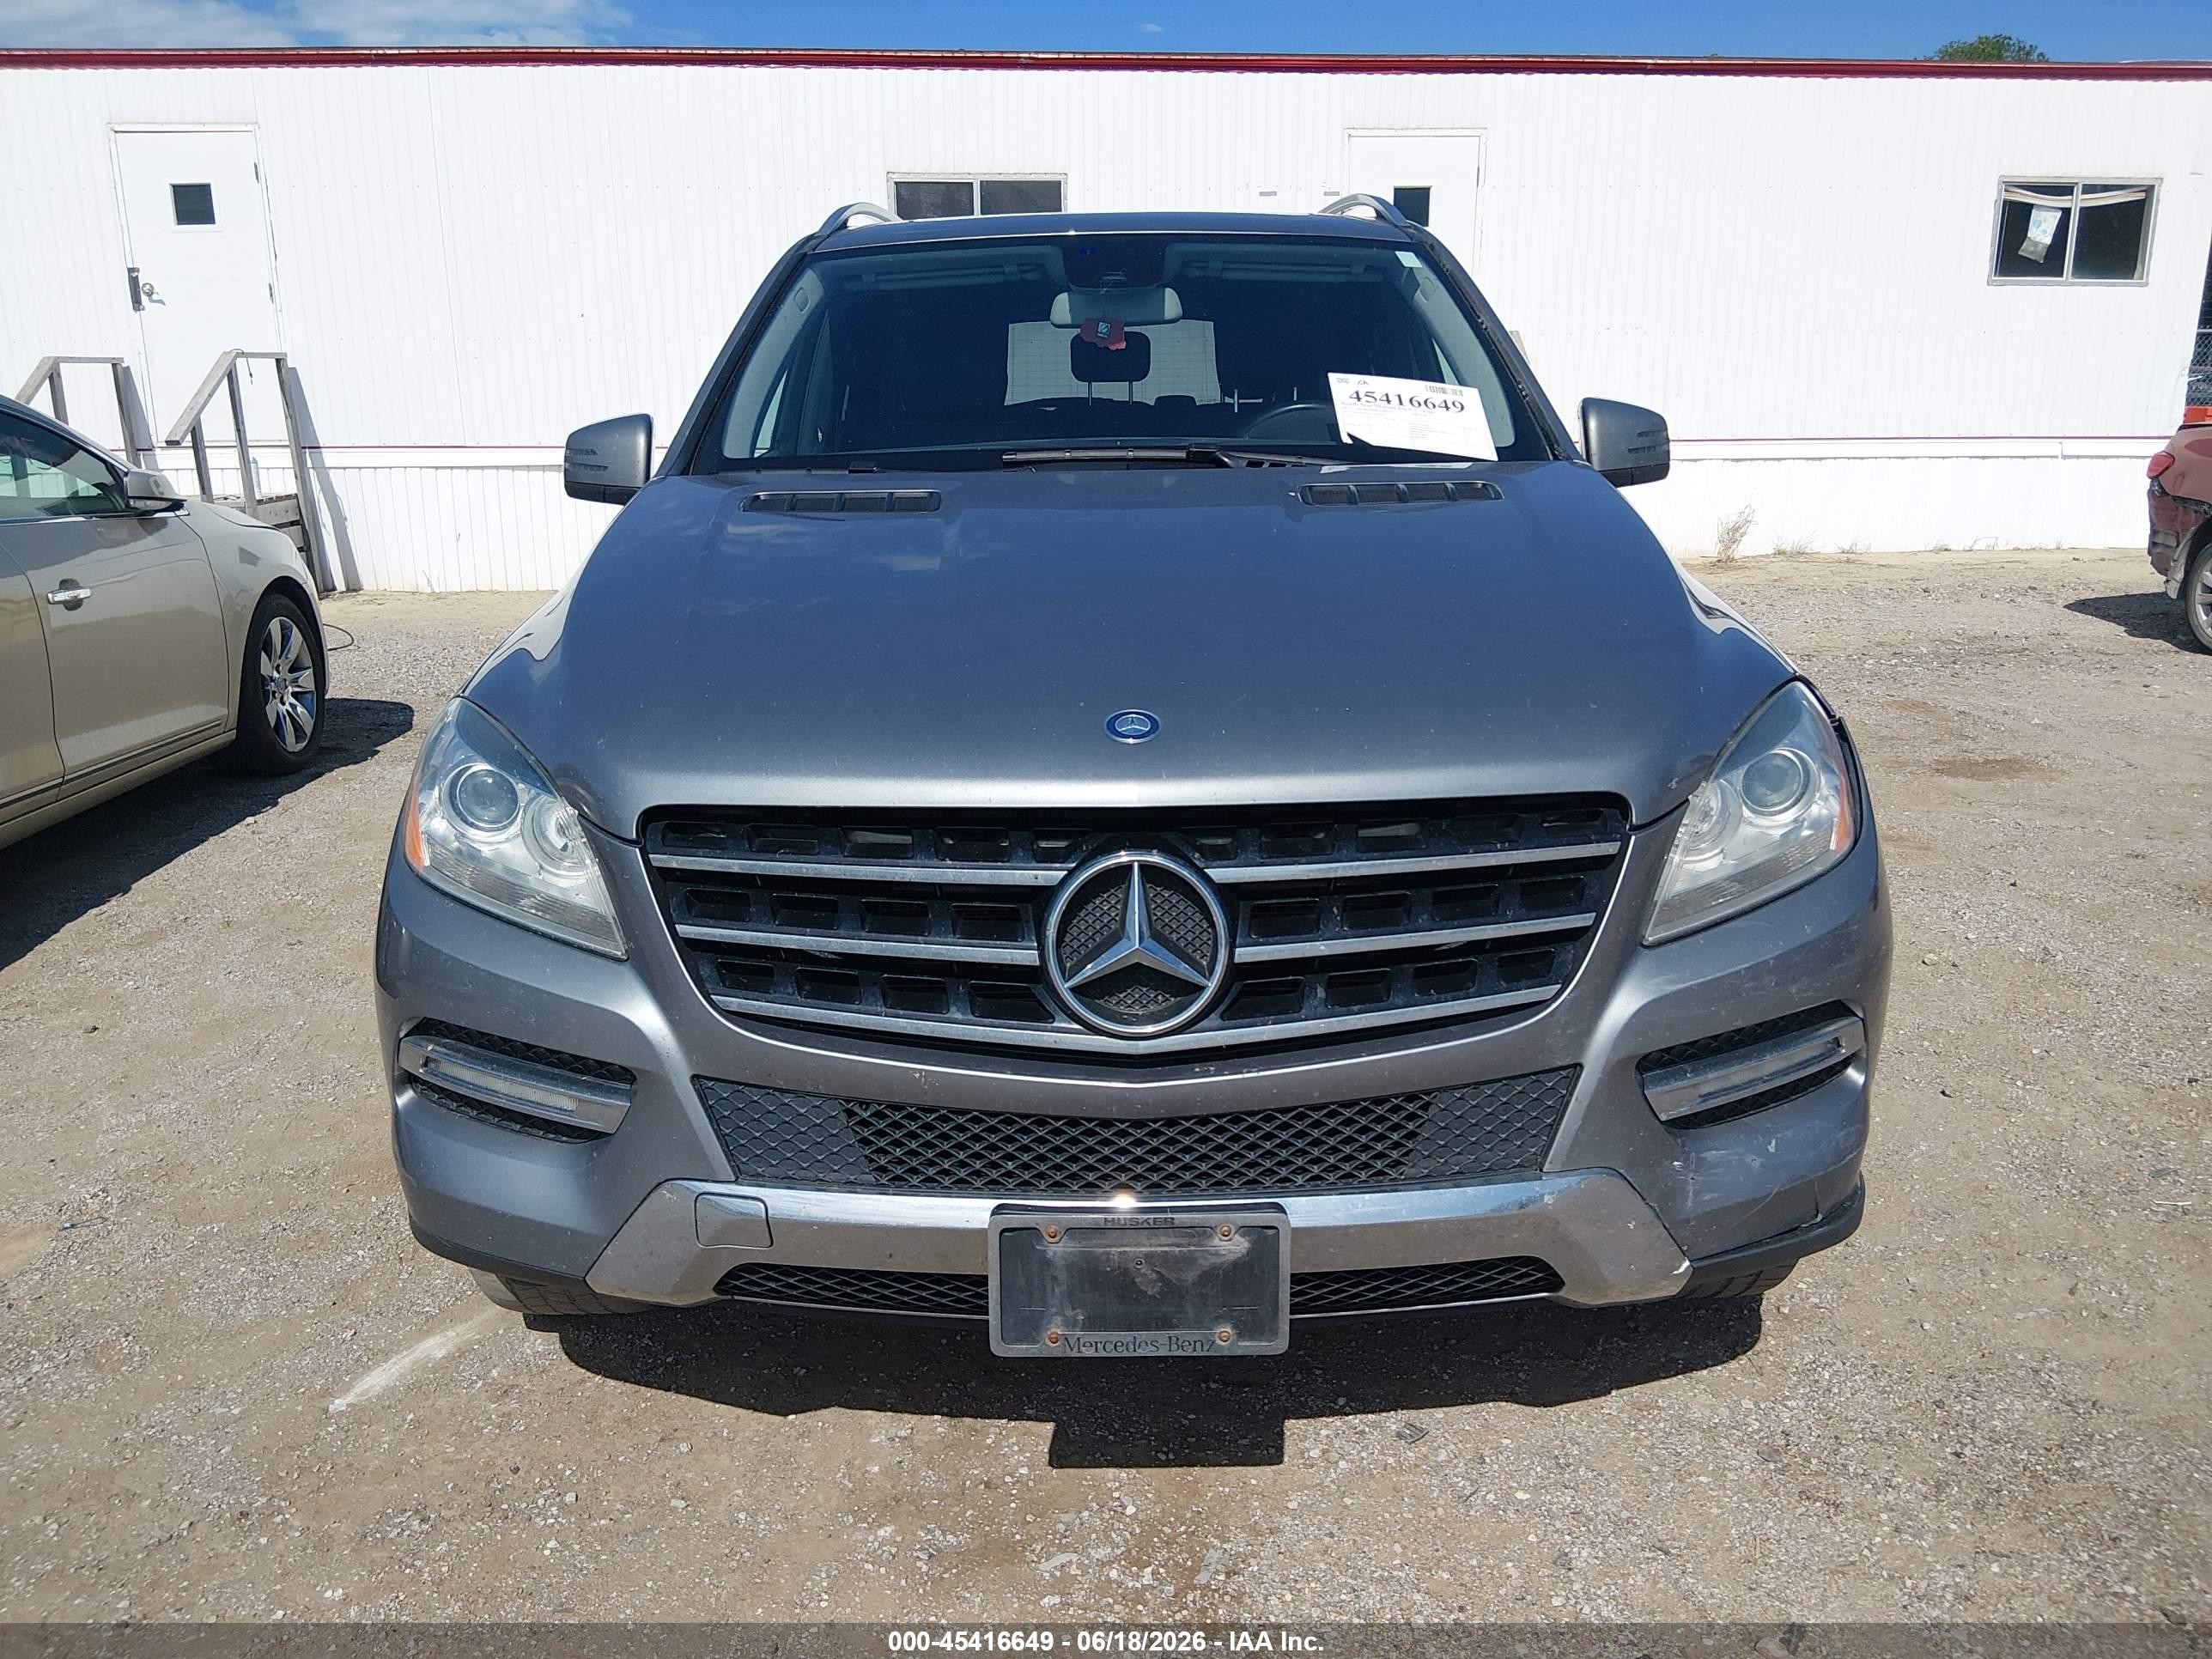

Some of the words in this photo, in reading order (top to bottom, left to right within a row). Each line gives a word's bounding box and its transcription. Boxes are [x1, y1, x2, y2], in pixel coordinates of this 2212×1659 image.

[1348, 389, 1466, 413] 45416649
[1103, 1216, 1176, 1227] HUSKER
[1063, 1335, 1217, 1354] Mercedes-Benz
